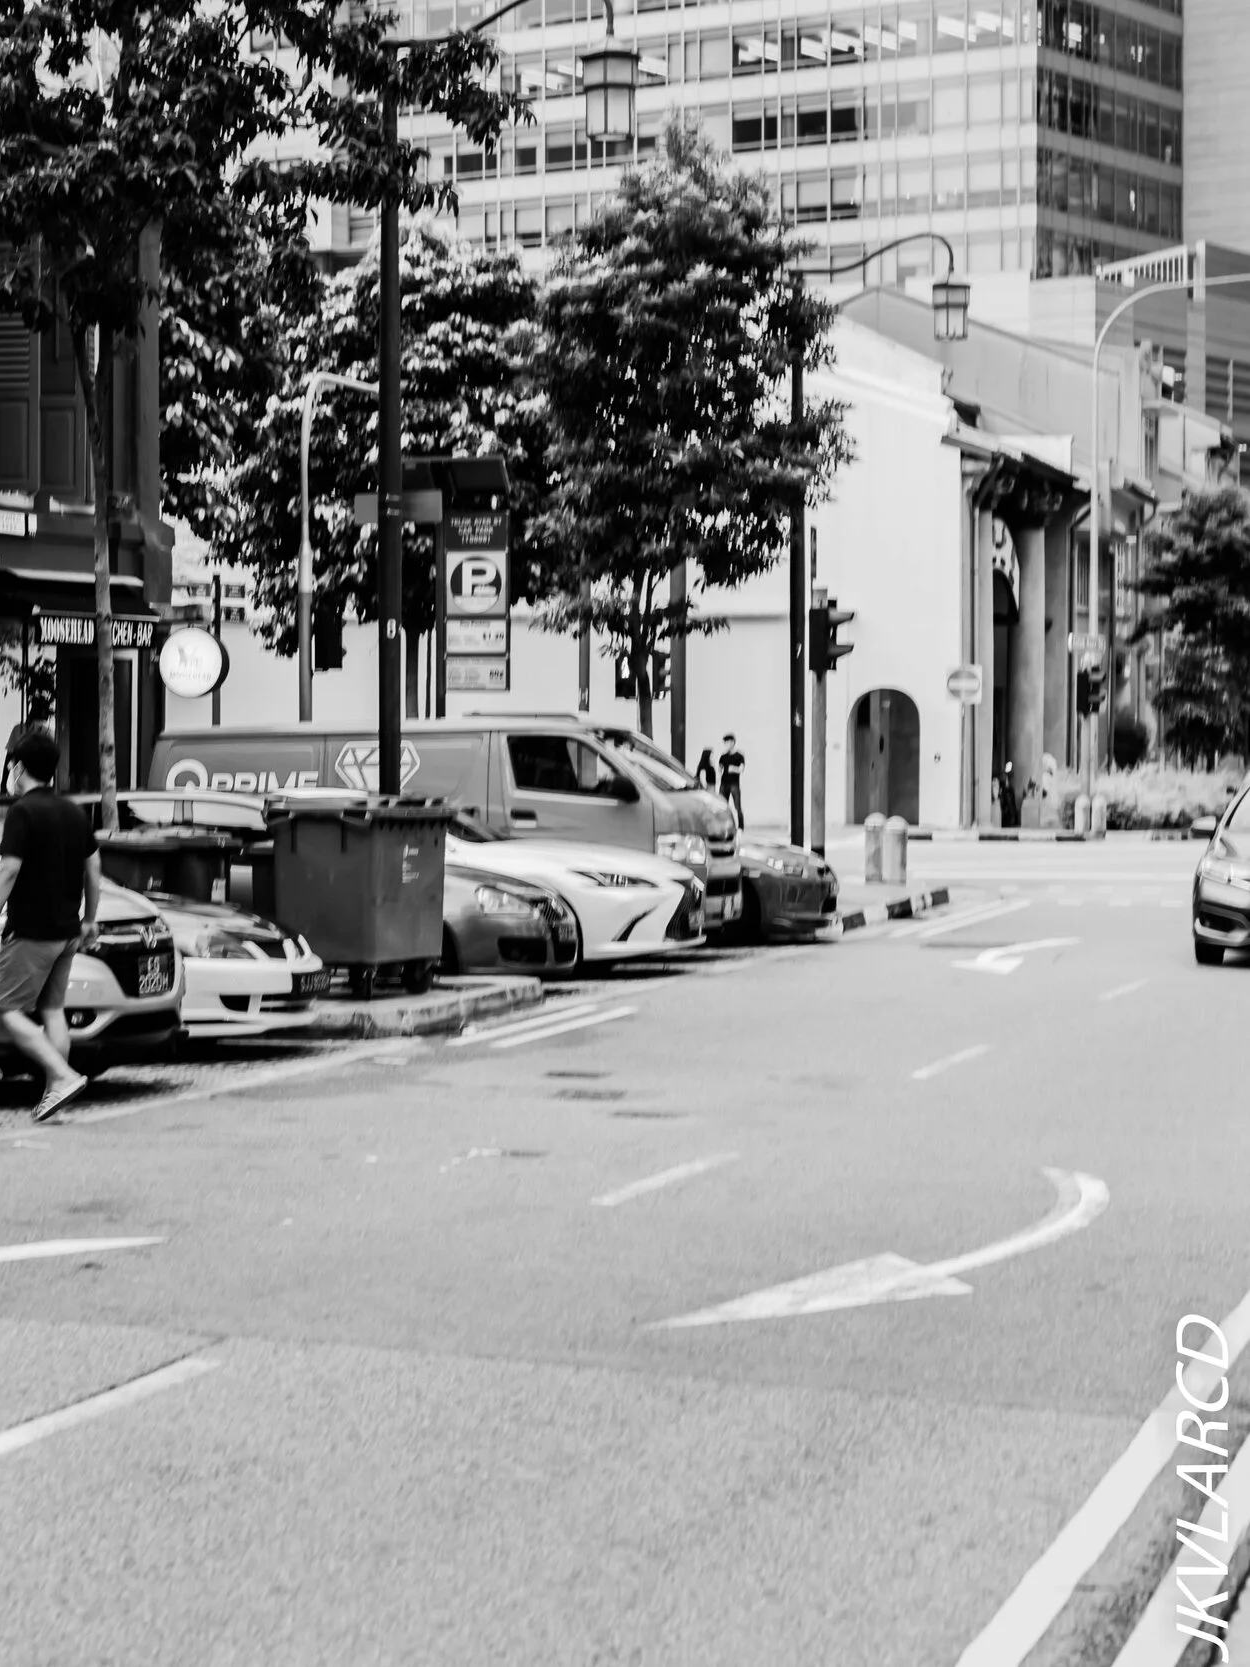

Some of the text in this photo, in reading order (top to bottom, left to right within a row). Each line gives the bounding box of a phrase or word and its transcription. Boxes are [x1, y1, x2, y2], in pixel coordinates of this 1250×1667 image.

[458, 525, 494, 536] CAR PARK
[461, 560, 498, 597] P
[40, 617, 153, 647] MOOSEHEAD CHEN BAR
